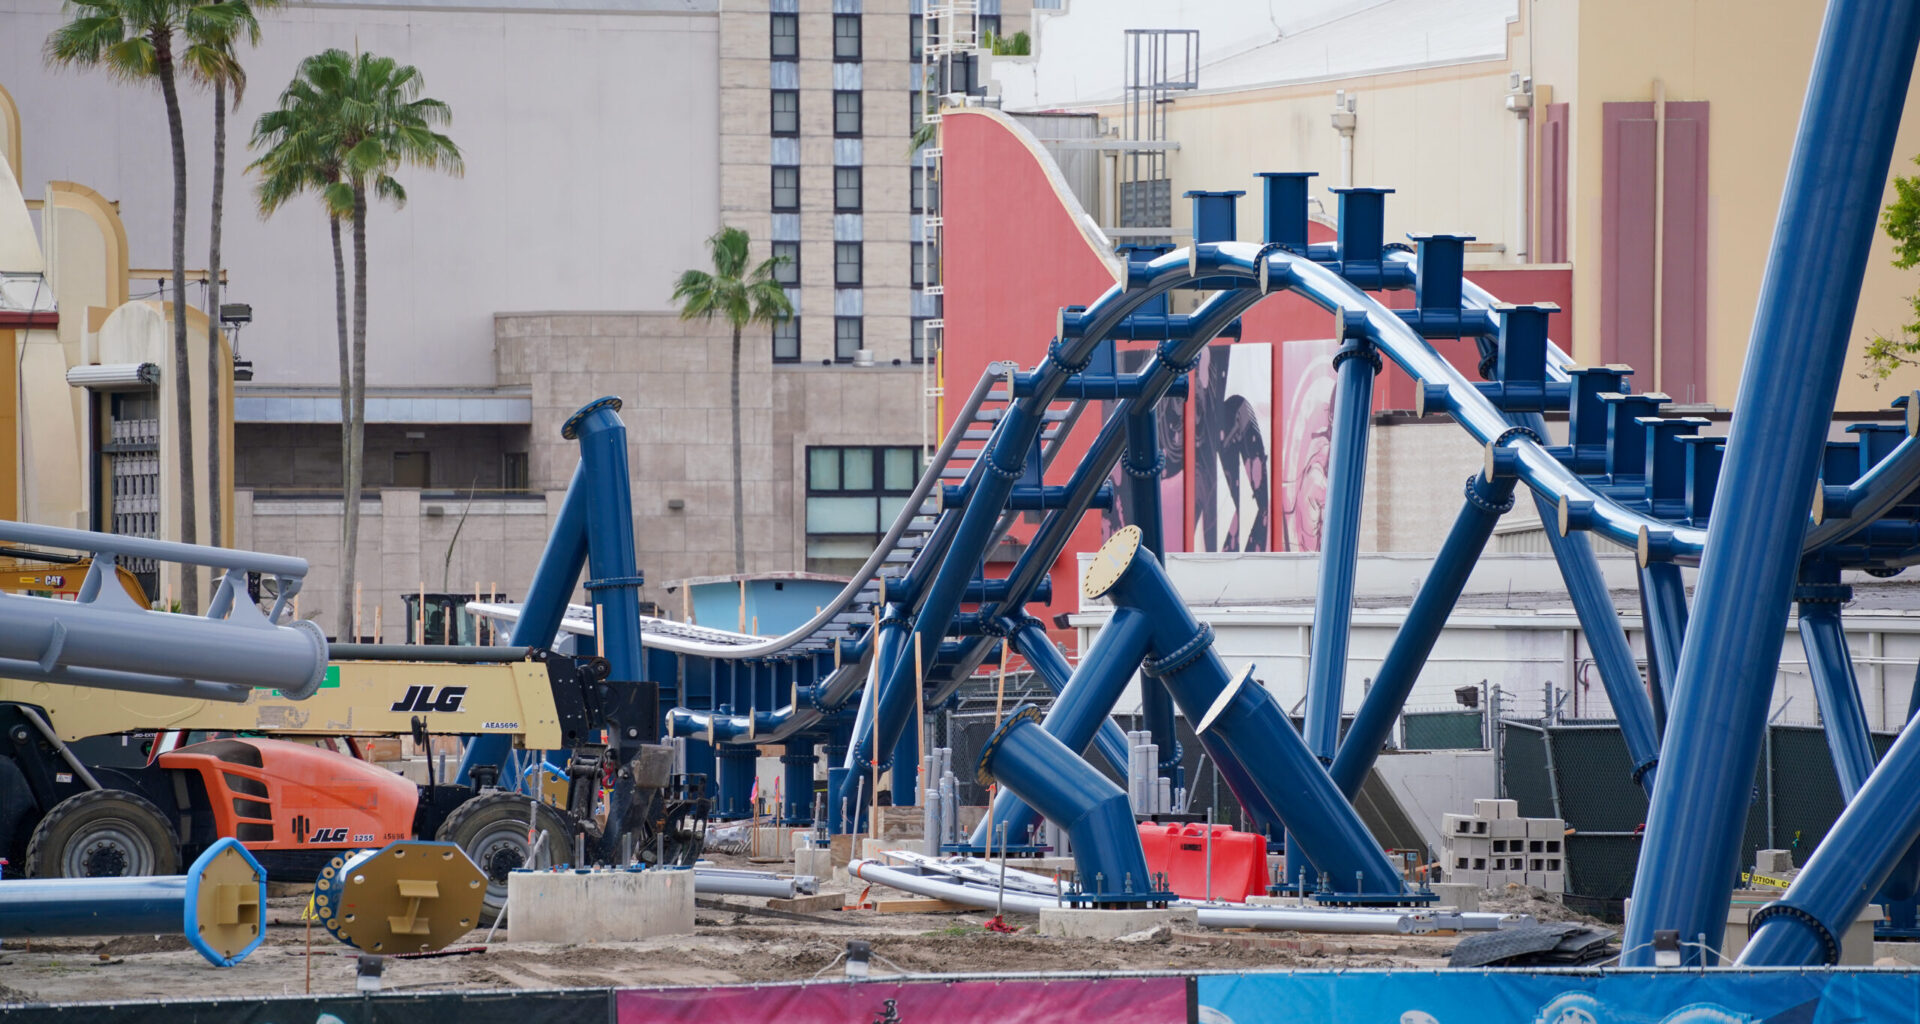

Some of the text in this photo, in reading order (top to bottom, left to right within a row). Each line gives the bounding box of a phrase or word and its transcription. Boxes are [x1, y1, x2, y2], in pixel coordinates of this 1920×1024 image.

[45, 575, 62, 586] CAT
[390, 685, 468, 712] JLG
[310, 828, 374, 843] JLG 1255
[1743, 873, 1776, 886] CUTION
